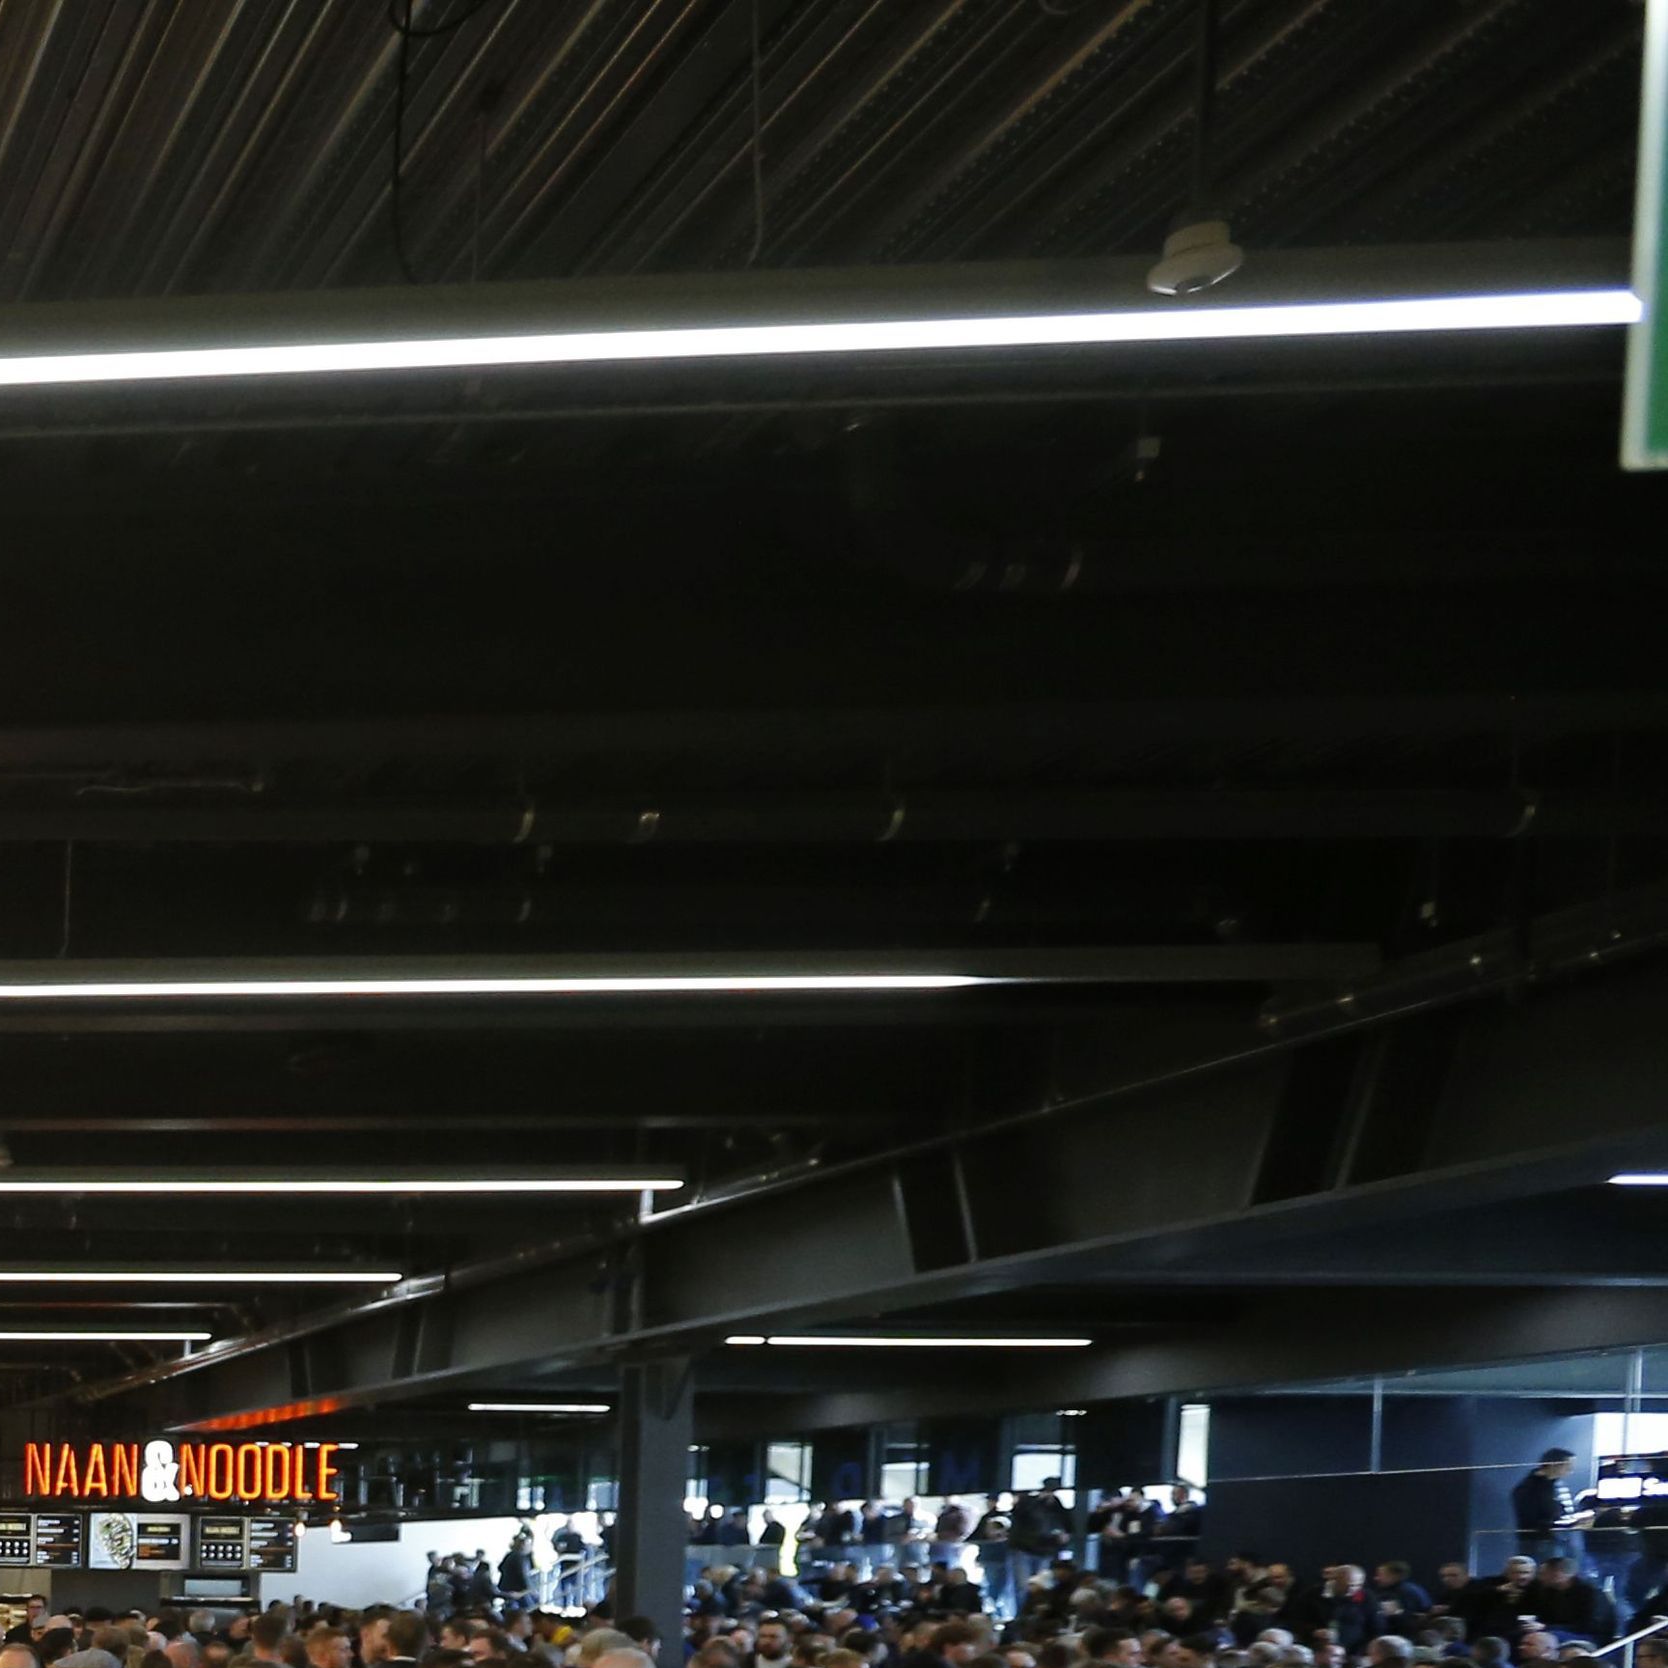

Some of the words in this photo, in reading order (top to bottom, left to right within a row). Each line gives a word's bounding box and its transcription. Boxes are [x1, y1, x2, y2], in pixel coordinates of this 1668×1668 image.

[25, 1442, 138, 1497] NAAN
[141, 1440, 181, 1502] &
[180, 1443, 339, 1500] NOODLE
